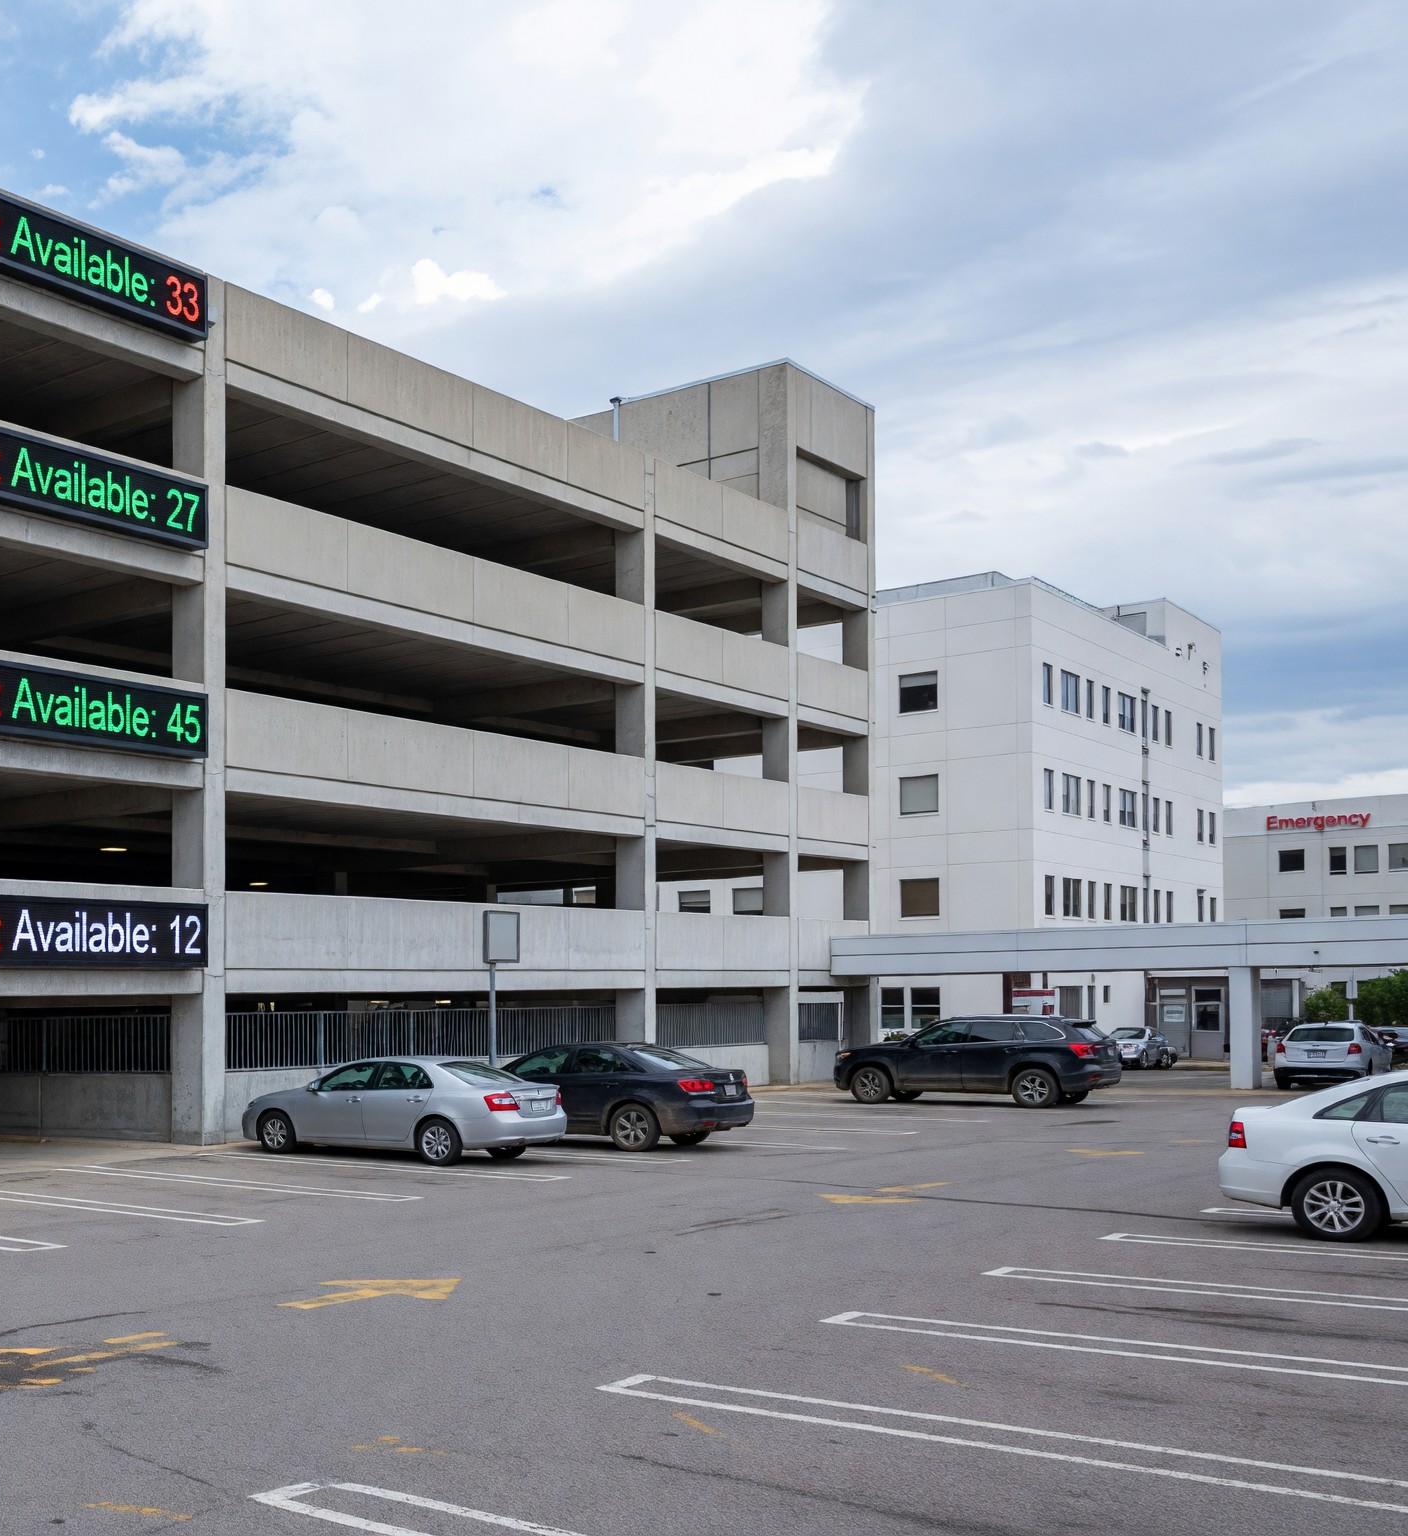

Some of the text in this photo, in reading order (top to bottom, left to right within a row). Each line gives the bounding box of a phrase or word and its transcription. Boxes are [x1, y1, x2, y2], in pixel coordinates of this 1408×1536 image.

[11, 216, 155, 306] Available:
[166, 276, 199, 322] 33
[11, 447, 155, 522] Available:
[167, 489, 199, 532] 27
[12, 678, 156, 738] Available:
[167, 703, 200, 743] 45
[12, 909, 156, 953] Available:
[170, 915, 200, 954] 12
